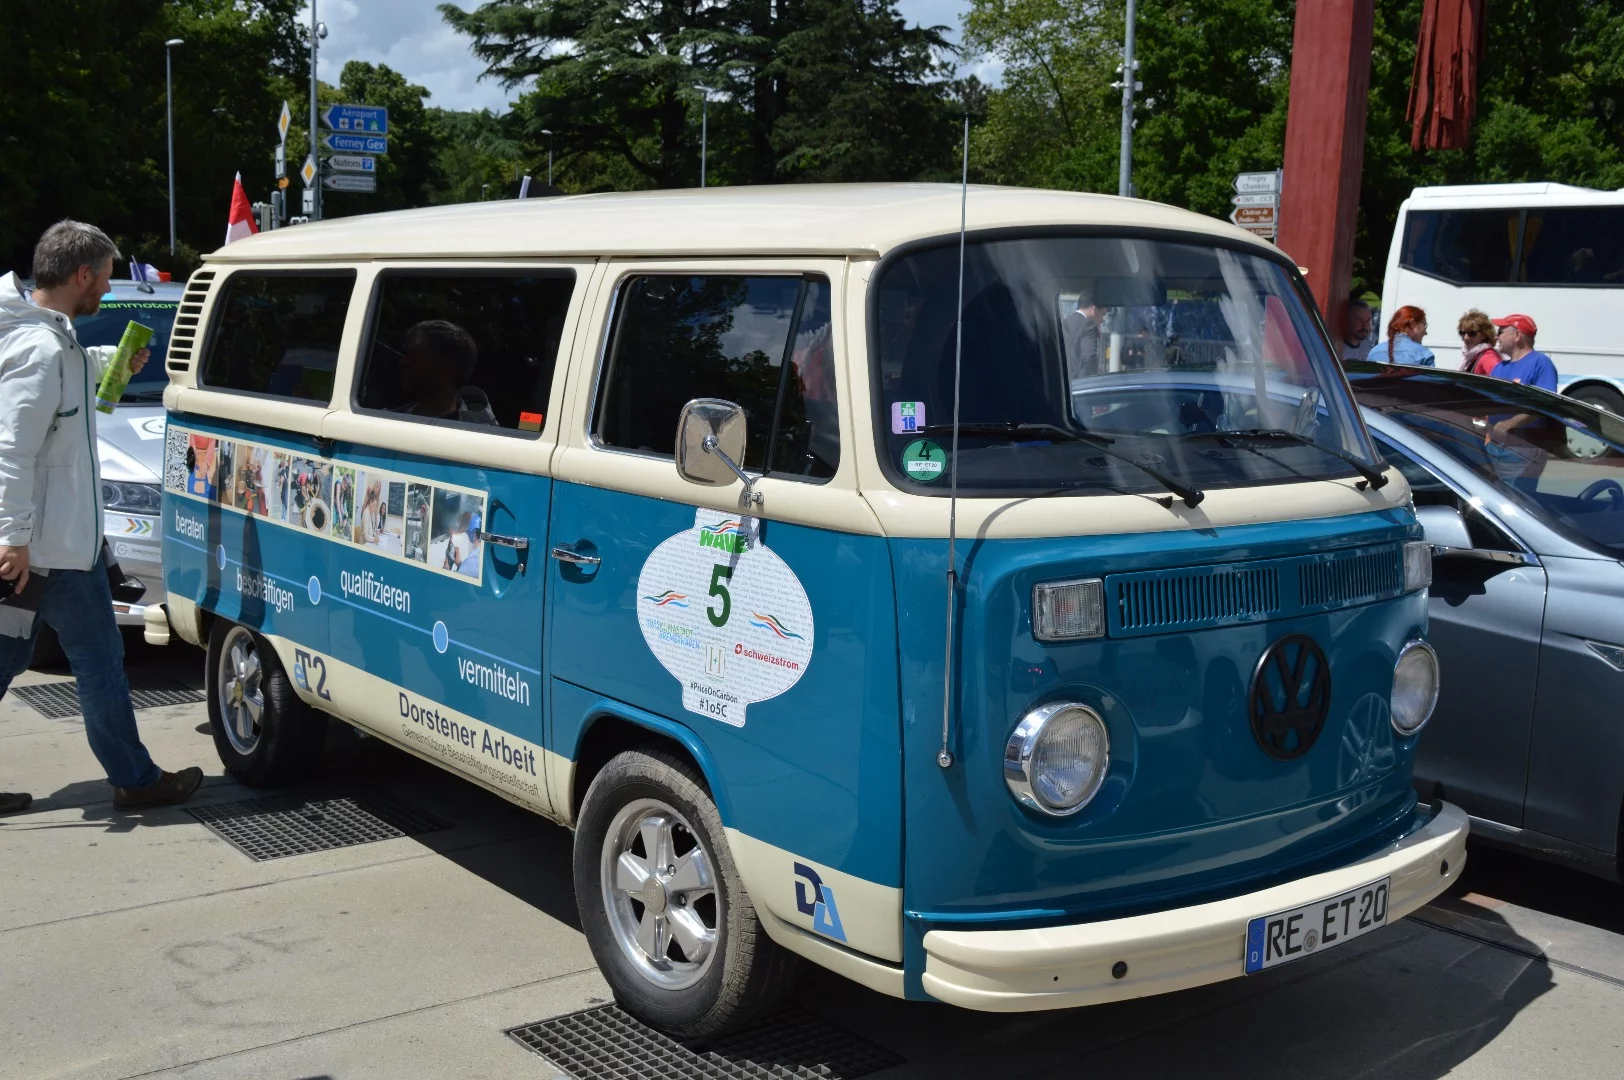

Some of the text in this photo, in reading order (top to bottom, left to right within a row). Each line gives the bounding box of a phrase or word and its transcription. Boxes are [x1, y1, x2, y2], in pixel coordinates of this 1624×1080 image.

[334, 136, 385, 151] Ferney Gex
[333, 158, 362, 169] Nations
[902, 416, 916, 430] 16
[918, 441, 931, 461] 4
[175, 509, 205, 541] beraten
[700, 529, 747, 554] WAVE
[236, 567, 294, 614] beschäftigen
[340, 569, 411, 614] qualifizieren
[706, 563, 733, 628] 5
[743, 649, 799, 671] schweizstrom
[458, 656, 530, 707] vermitteln
[690, 682, 738, 703] #PriceOnCarbon
[398, 691, 537, 777] Dorstener Arbeit
[1251, 951, 1259, 963] D
[1266, 913, 1304, 962] RE
